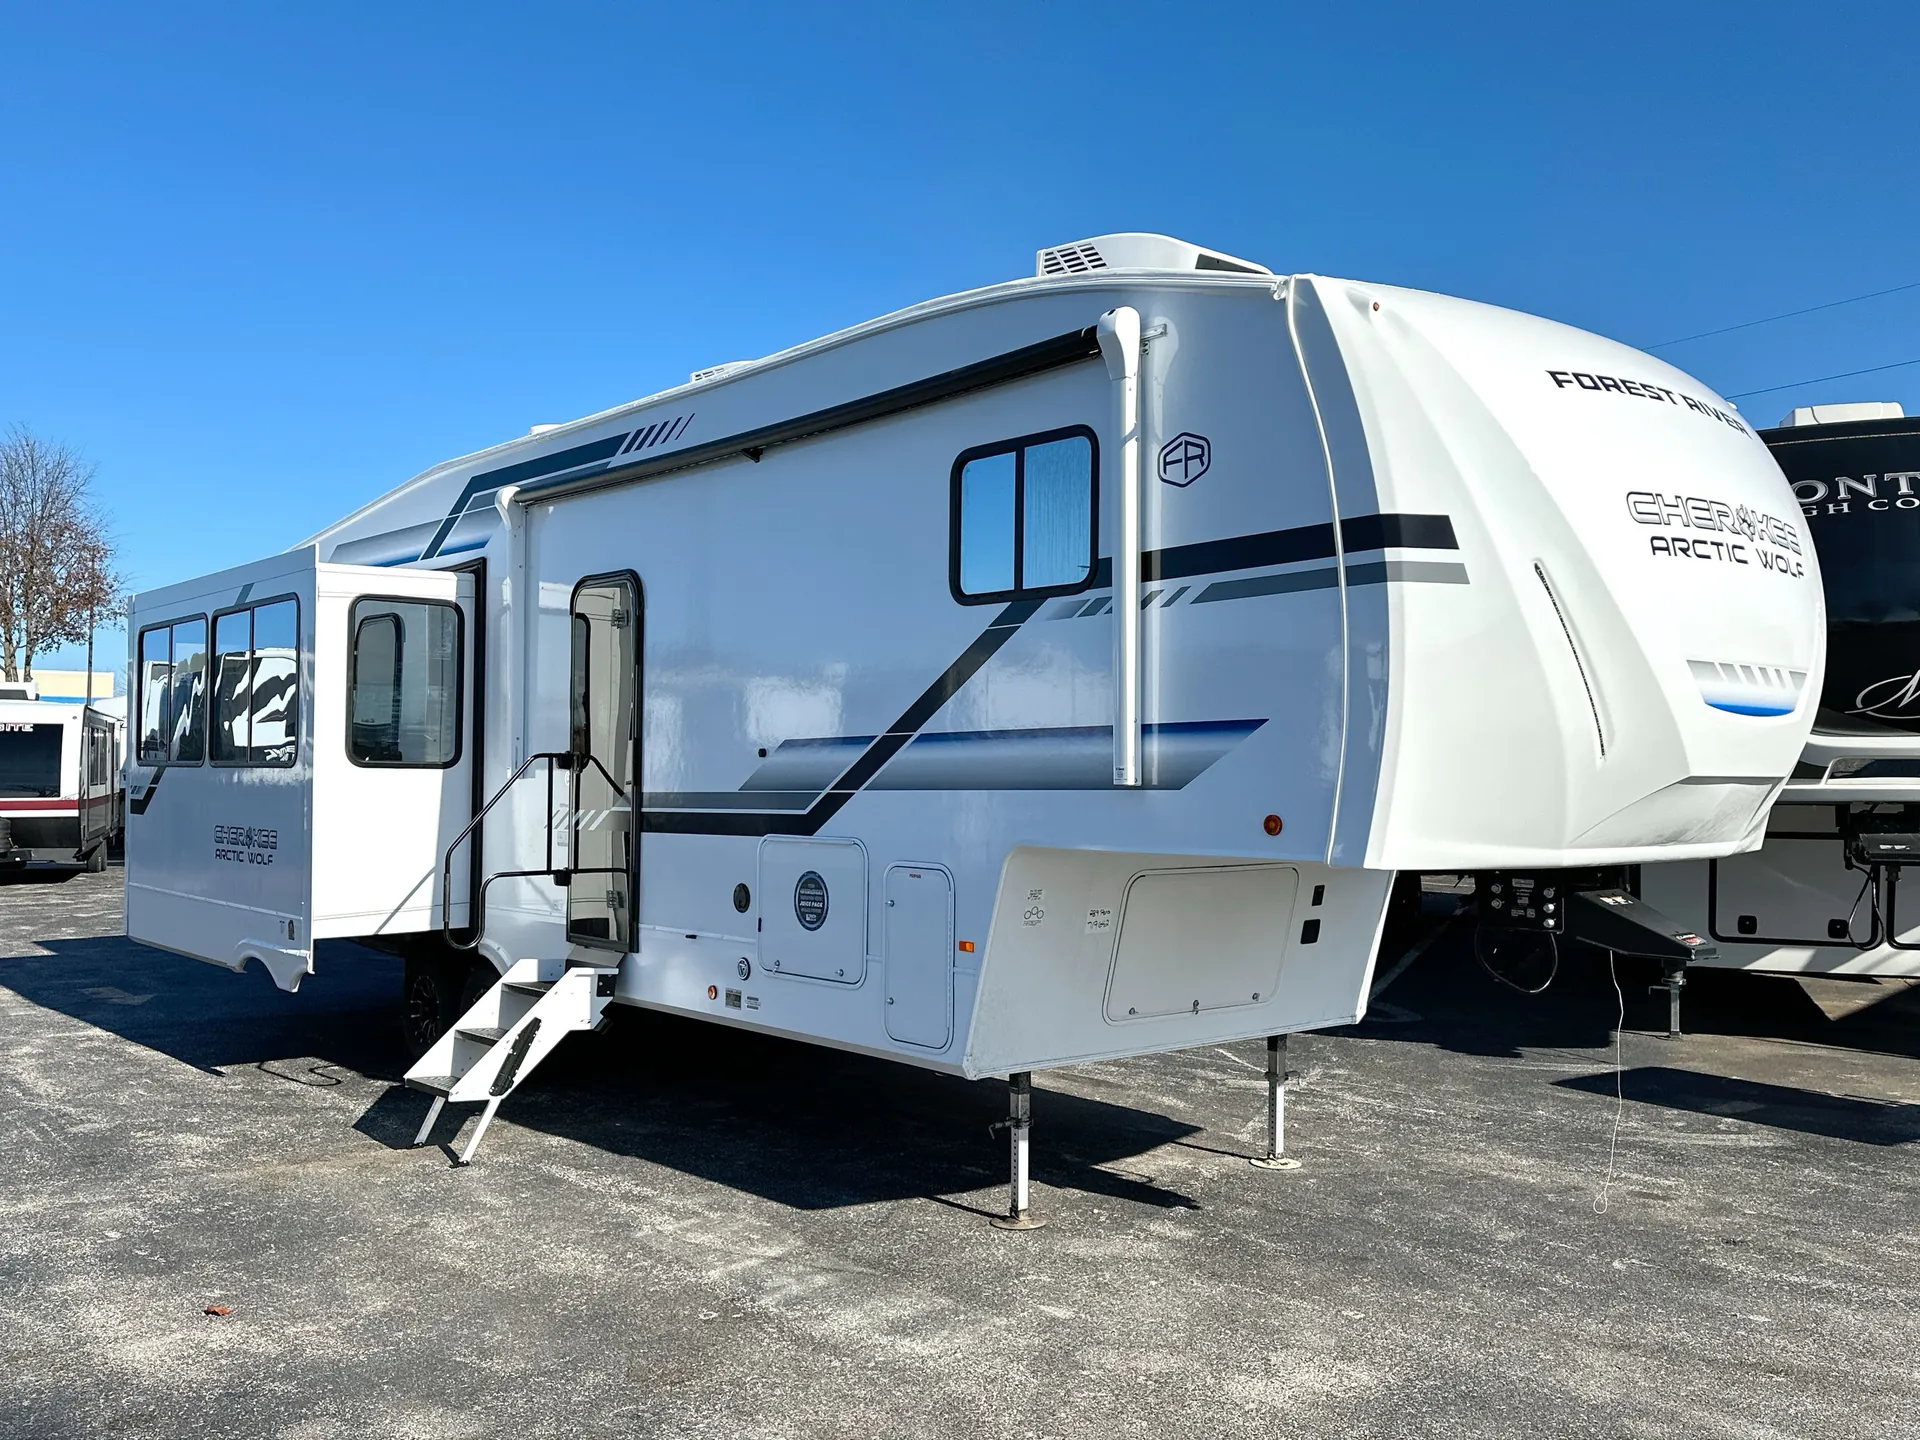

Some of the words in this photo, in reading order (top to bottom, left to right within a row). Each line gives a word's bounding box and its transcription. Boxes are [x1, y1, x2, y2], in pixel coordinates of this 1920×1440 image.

[1545, 369, 1679, 406] FOREST
[1678, 393, 1753, 440] RIVER
[1650, 535, 1749, 564] ARCTIC
[1755, 548, 1804, 579] WOLF
[215, 848, 244, 862] ARCTIC
[247, 851, 273, 866] WOLF
